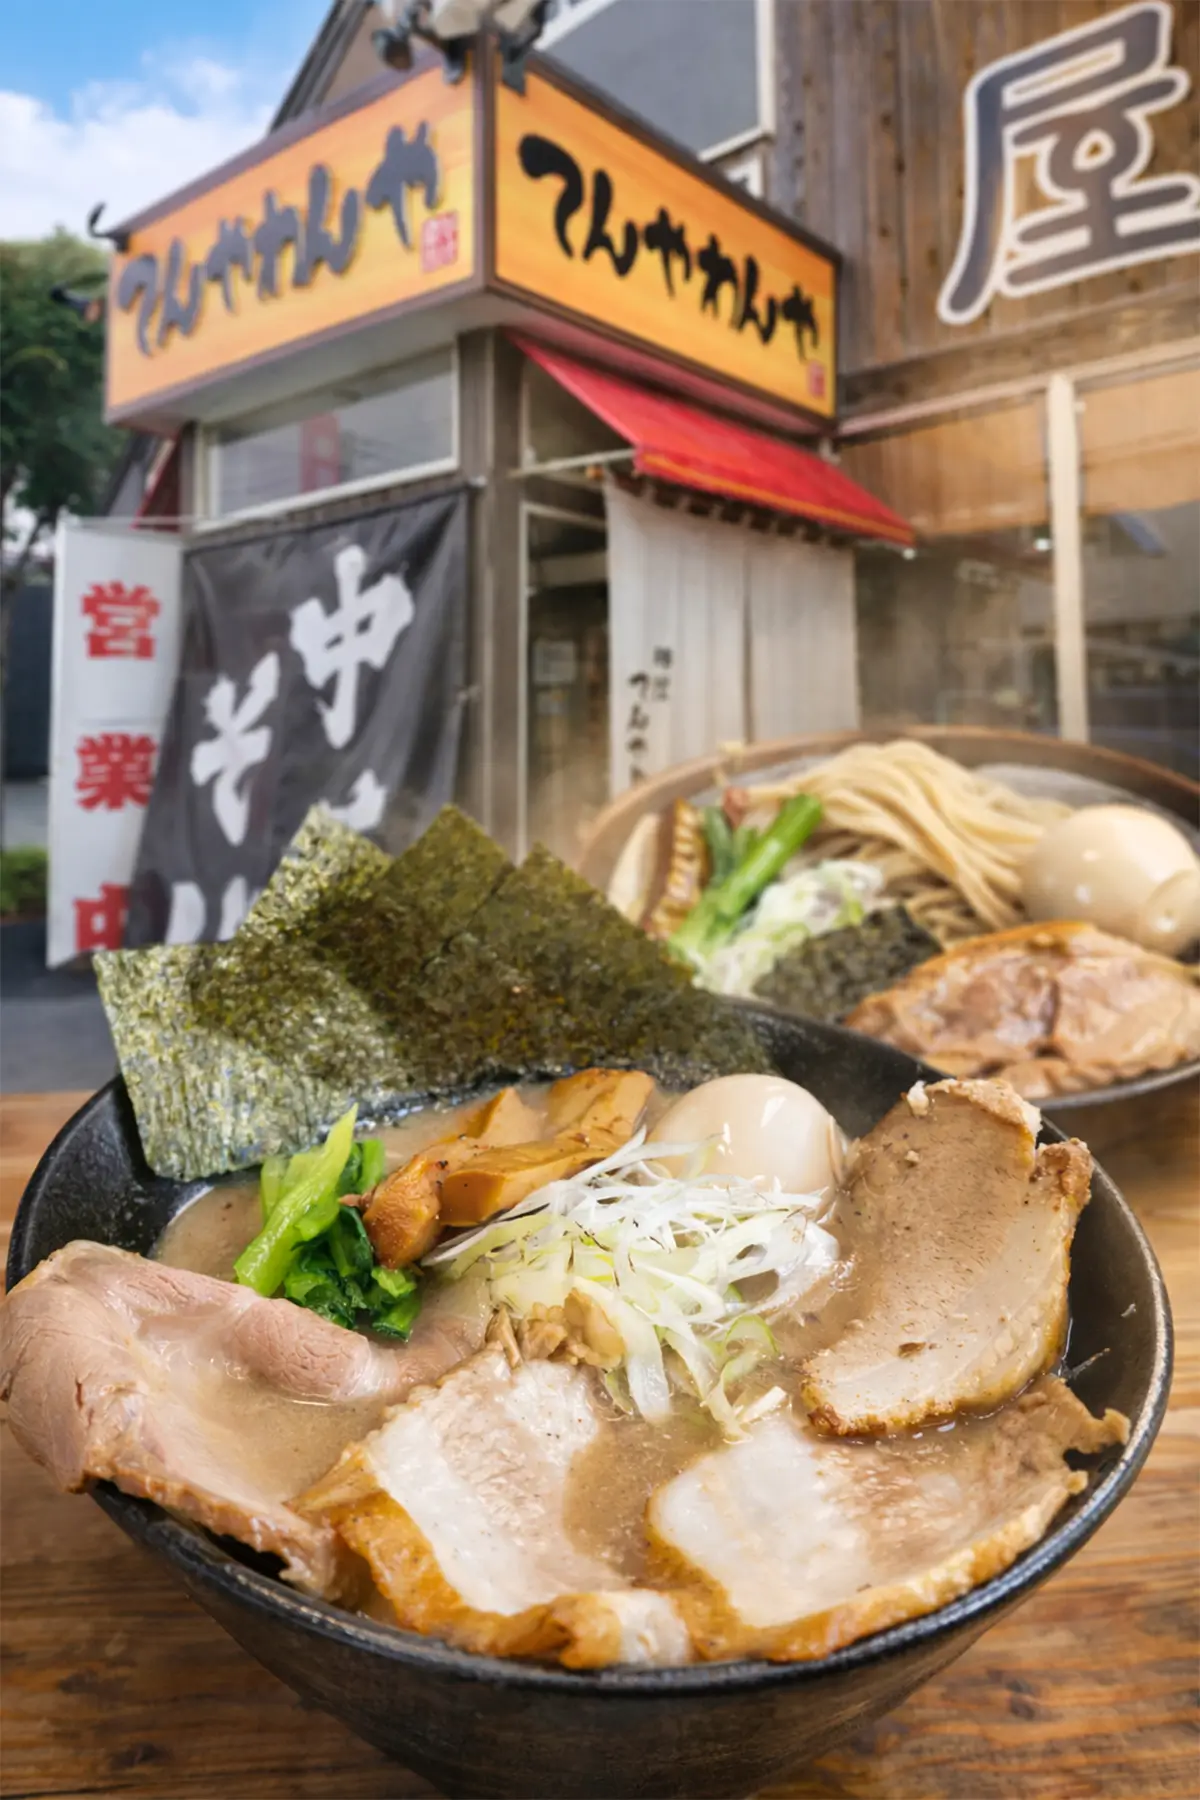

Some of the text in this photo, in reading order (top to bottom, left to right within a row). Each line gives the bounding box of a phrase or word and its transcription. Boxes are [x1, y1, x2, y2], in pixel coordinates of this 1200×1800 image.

[118, 121, 440, 357] てんやわんや
[518, 133, 820, 363] てんやわんや
[937, 0, 1200, 325] 屋
